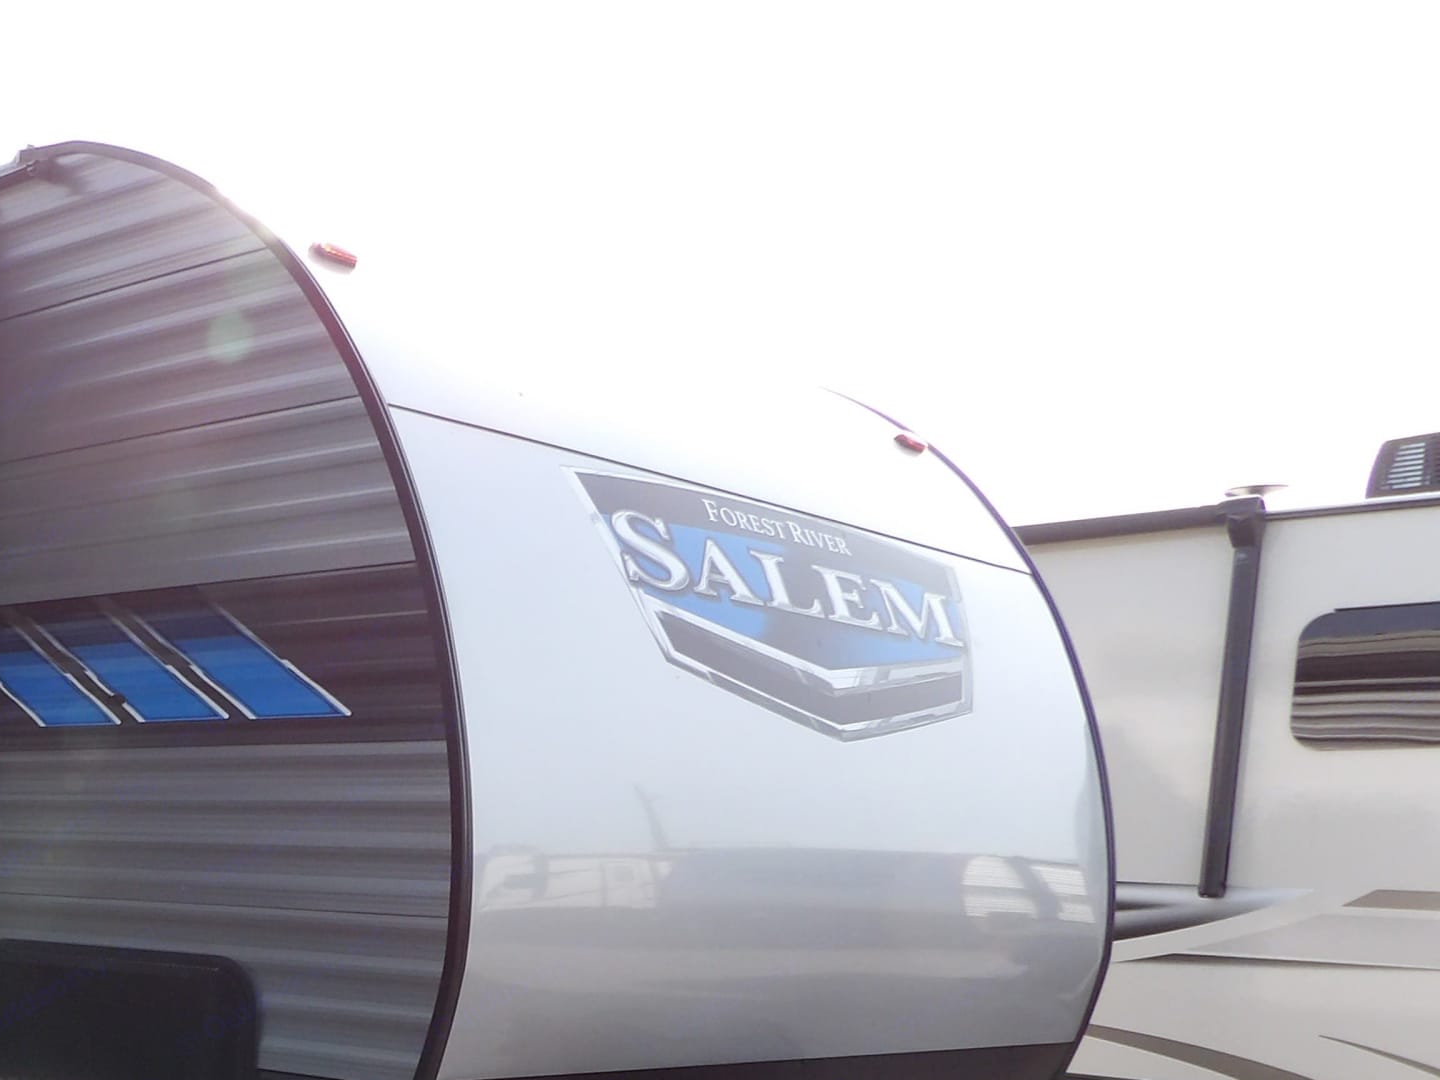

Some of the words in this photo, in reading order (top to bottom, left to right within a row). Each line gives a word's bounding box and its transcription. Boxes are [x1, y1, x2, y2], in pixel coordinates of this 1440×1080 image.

[701, 498, 787, 540] FOREST
[787, 520, 852, 557] RIVER
[610, 508, 964, 648] SALEM
